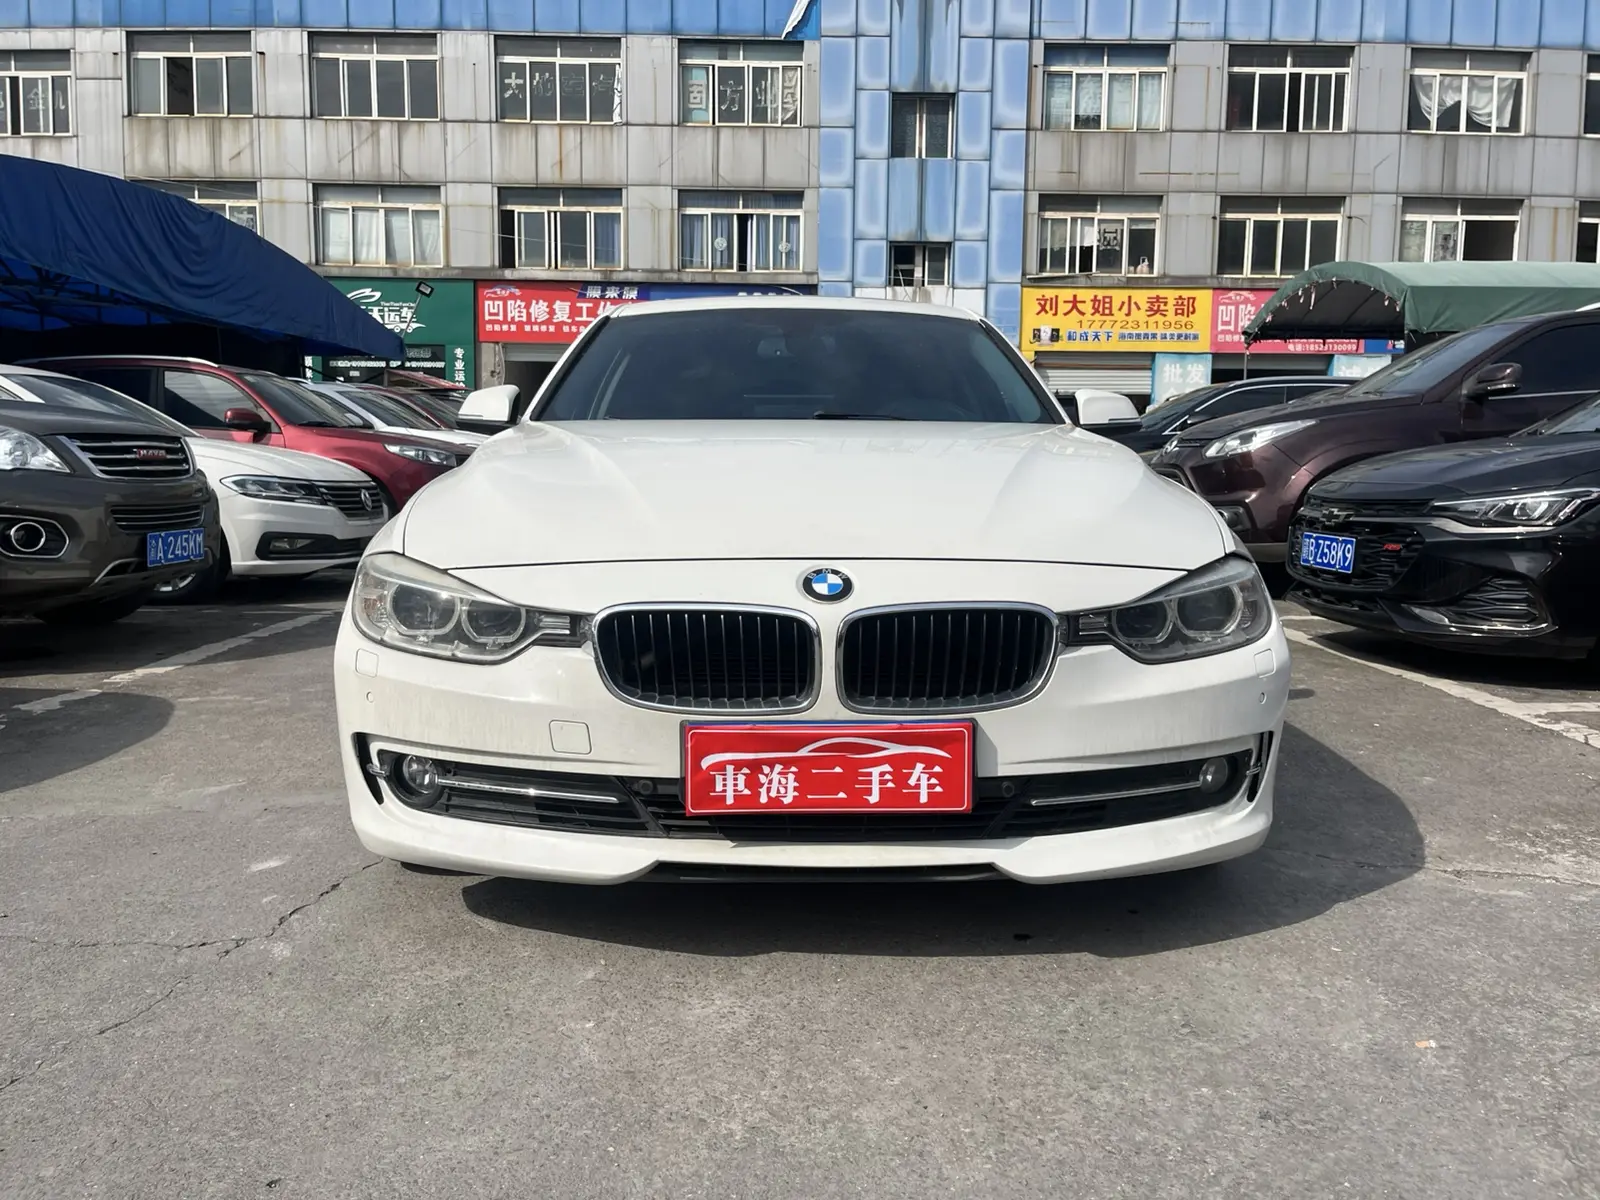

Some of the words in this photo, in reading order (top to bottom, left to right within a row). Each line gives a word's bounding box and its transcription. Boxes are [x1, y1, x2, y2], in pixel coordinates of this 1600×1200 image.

[361, 306, 417, 323] 天运车
[1035, 294, 1197, 318] 刘大姐小卖部
[1076, 319, 1194, 330] 17772311956
[1066, 331, 1114, 342] 和成天下
[1163, 363, 1204, 384] 批发
[807, 568, 848, 579] BMW
[709, 762, 944, 805] 車海二手车
